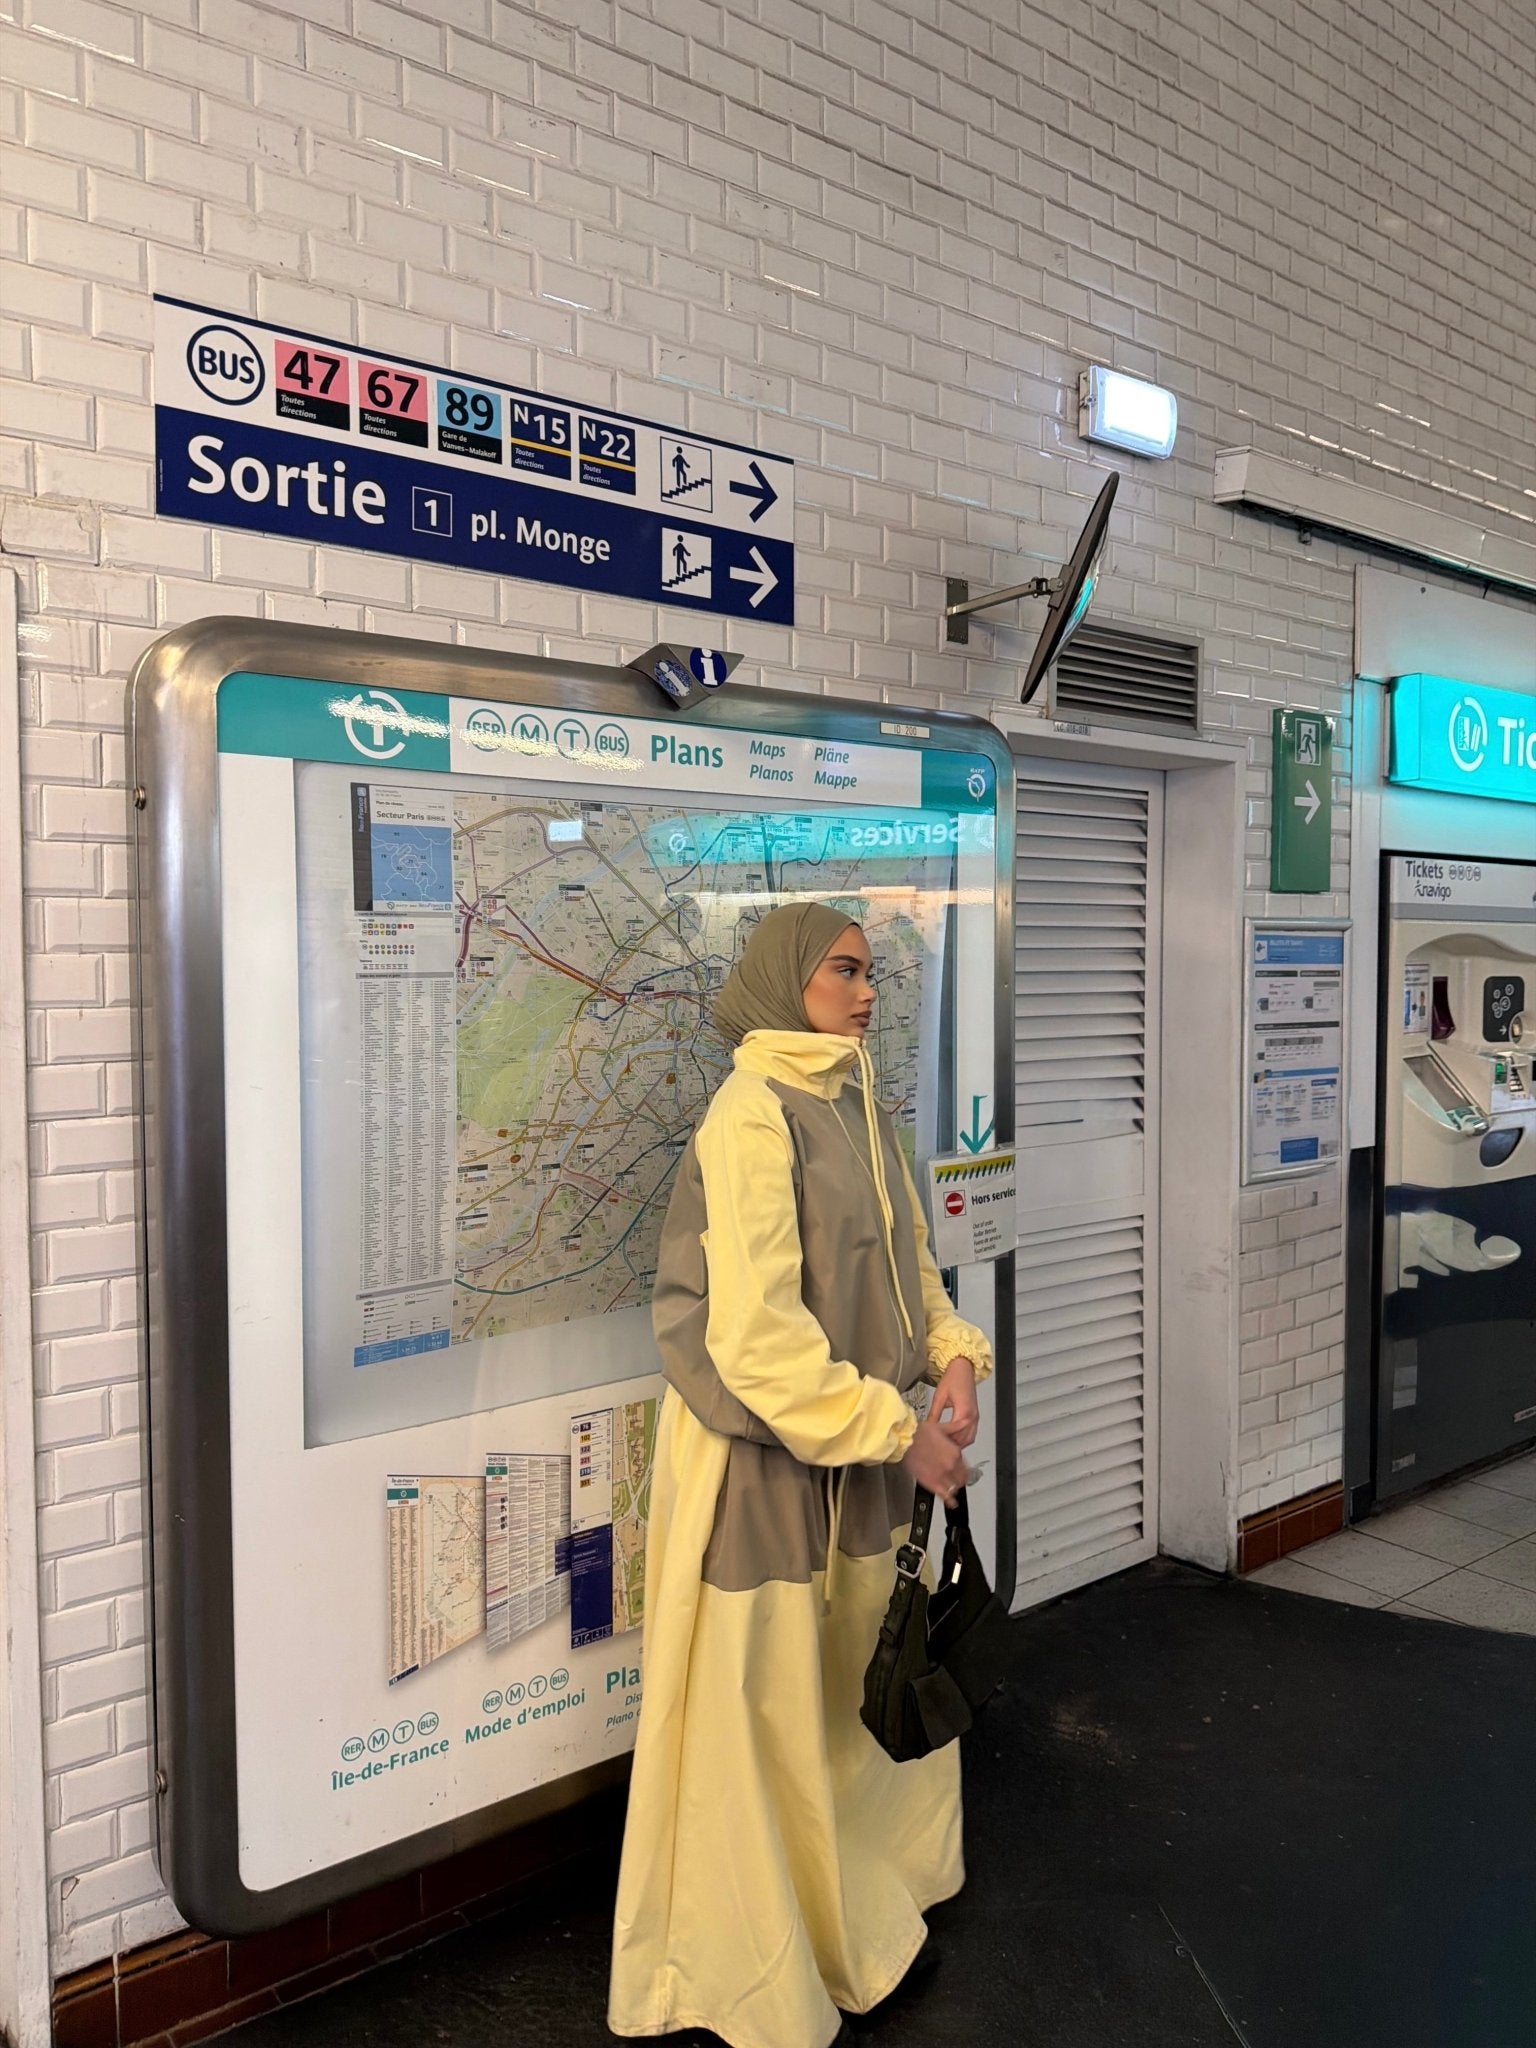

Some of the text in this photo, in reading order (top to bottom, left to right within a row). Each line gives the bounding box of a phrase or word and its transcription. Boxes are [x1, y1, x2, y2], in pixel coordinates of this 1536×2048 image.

[198, 345, 255, 384] BUS
[283, 350, 340, 395] 47
[280, 394, 305, 406] Toutes
[367, 369, 419, 413] 67
[280, 404, 317, 420] directions
[445, 387, 495, 431] 89
[364, 413, 386, 425] Toutes
[363, 423, 397, 437] directions
[441, 430, 468, 443] Gare de
[515, 447, 535, 459] Toutes
[514, 456, 545, 470] directions
[583, 463, 602, 475] Toutes
[582, 471, 611, 486] directions
[187, 434, 387, 525] Sortie
[423, 499, 437, 527] 1
[471, 509, 506, 542] pl.
[516, 517, 611, 564] Monge
[563, 728, 581, 751] T
[599, 735, 625, 753] BUS
[650, 734, 724, 769] Plans
[749, 740, 850, 764] Maps Pläne
[749, 764, 858, 789] Planos Mappe
[376, 810, 405, 820] Secteur
[406, 812, 425, 821] Paris
[1405, 860, 1444, 879] Tickets
[971, 1194, 991, 1206] Hors
[580, 1434, 591, 1443] 102
[484, 1673, 567, 1710] RER M T BUS
[606, 1711, 634, 1728] Plano
[344, 1715, 437, 1756] RER M T BUS
[464, 1716, 512, 1744] Mode
[331, 1739, 450, 1790] Île-de-France
